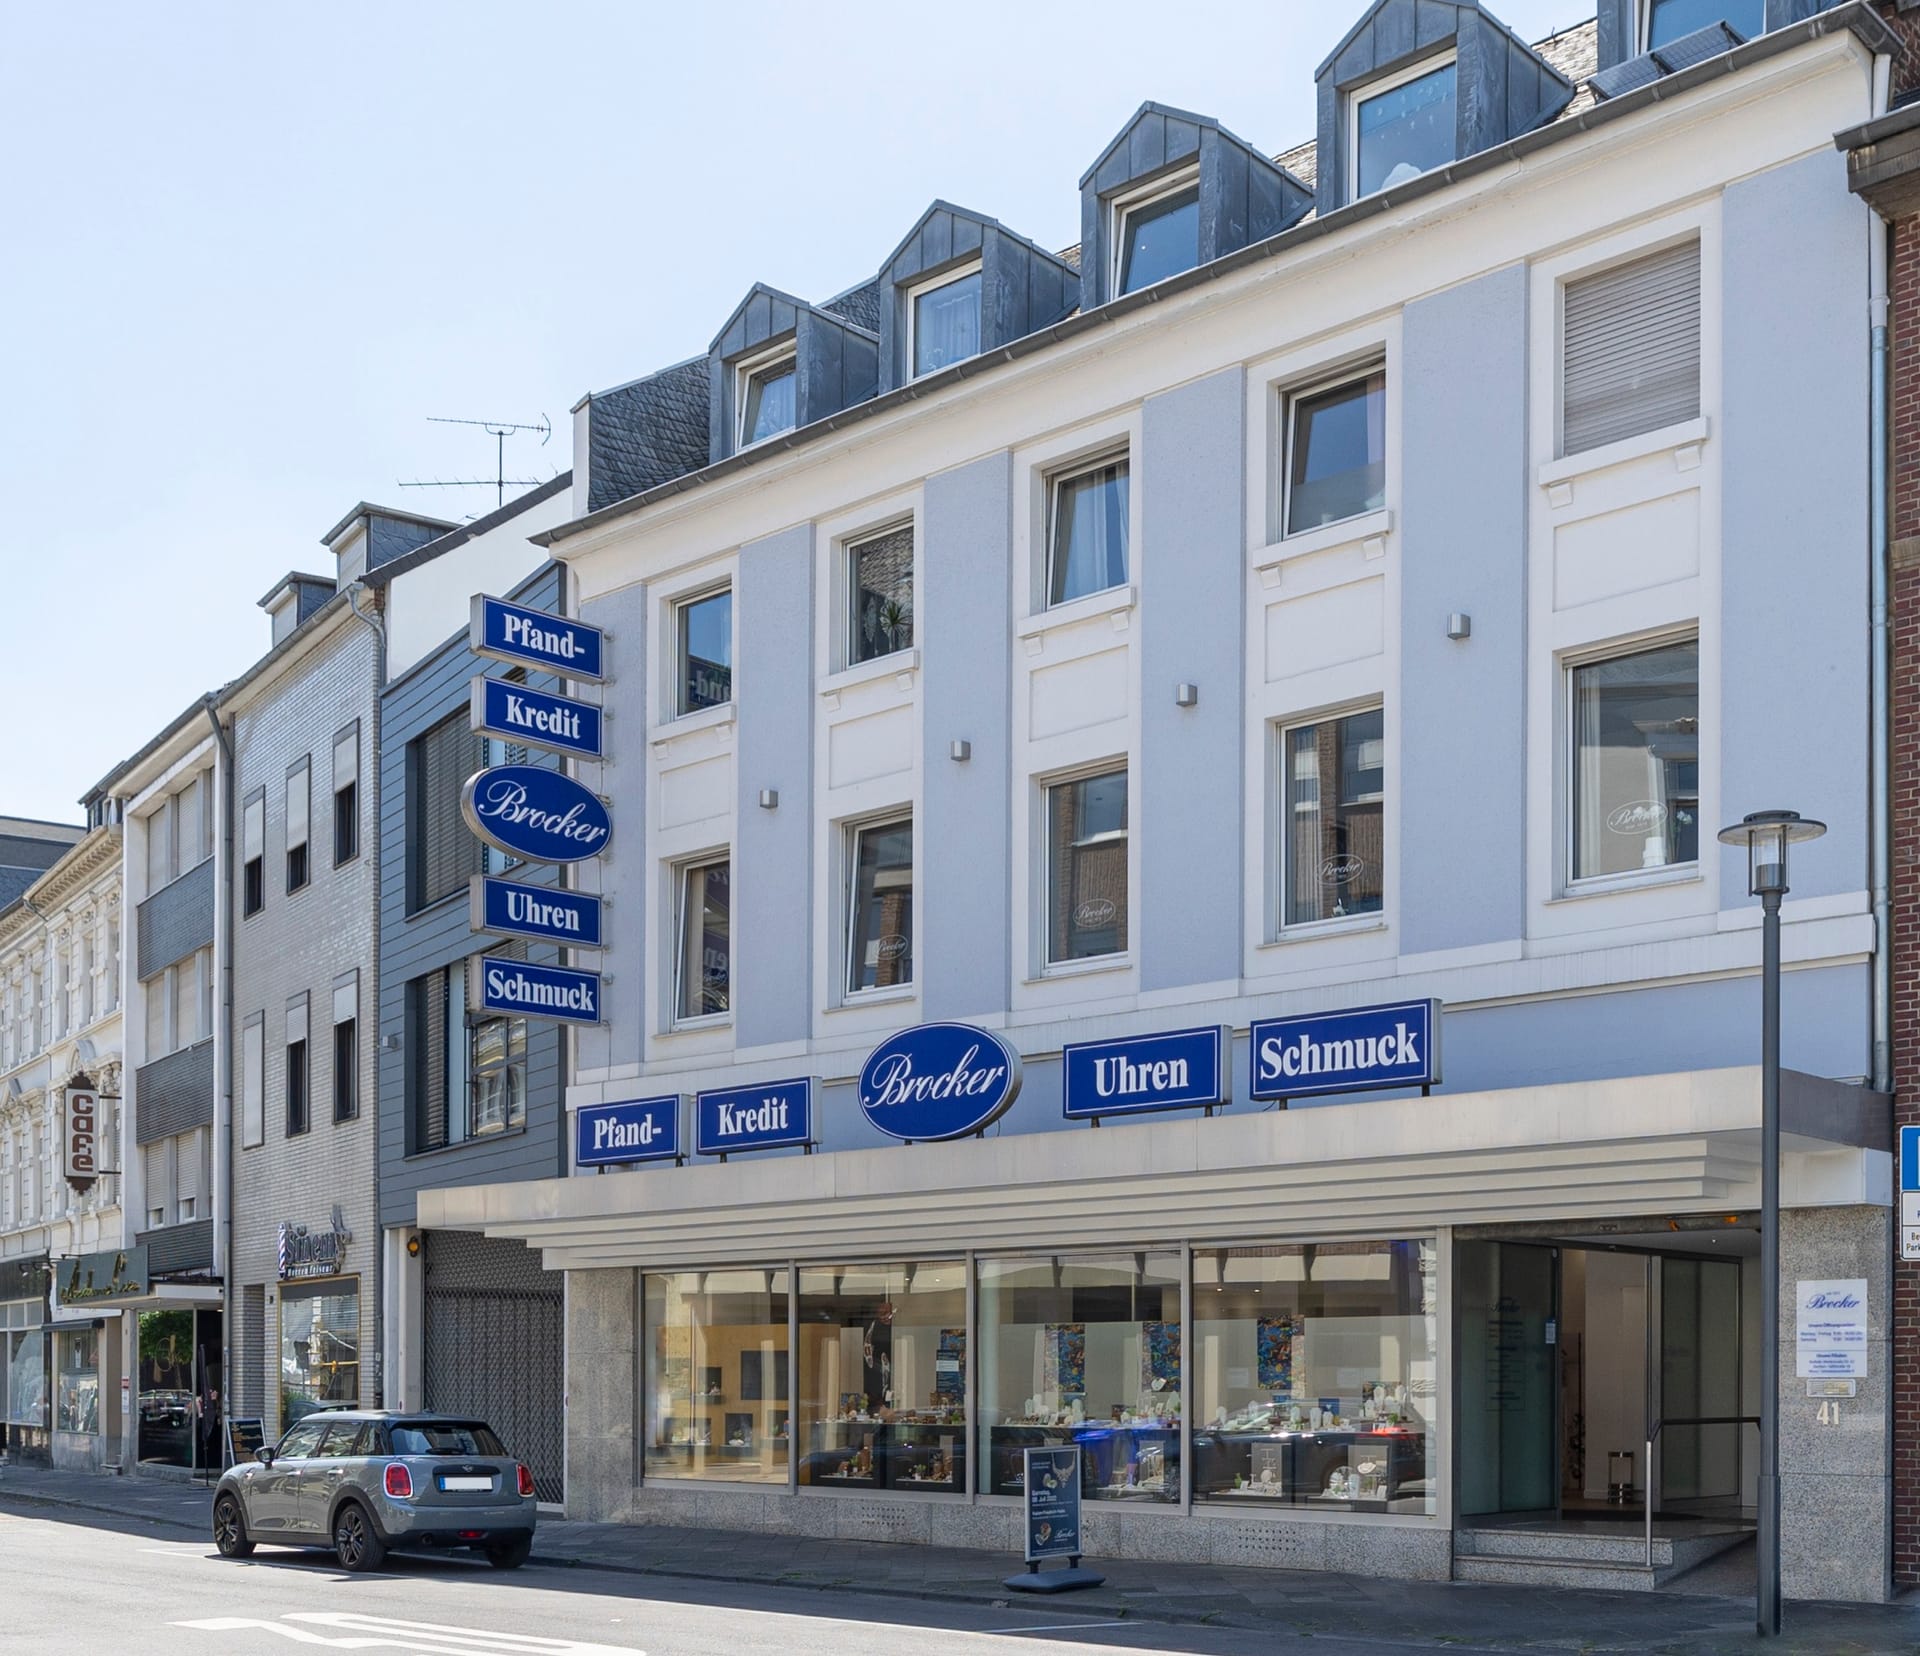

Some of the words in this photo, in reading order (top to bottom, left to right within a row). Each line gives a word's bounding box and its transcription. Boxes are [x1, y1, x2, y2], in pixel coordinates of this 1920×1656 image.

[503, 613, 585, 659] Pfand-
[506, 694, 581, 740] Kredit
[477, 779, 606, 843] Brocker
[506, 890, 580, 932] Uhren
[487, 968, 594, 1012] Schmuck
[1260, 1022, 1420, 1080] Schmuck
[863, 1044, 1005, 1108] Brocker
[1093, 1056, 1189, 1097] Uhren
[593, 1113, 662, 1150] Pfand-
[718, 1096, 788, 1136] Kredit
[1806, 1294, 1860, 1309] Brocker
[1816, 1401, 1839, 1425] 41
